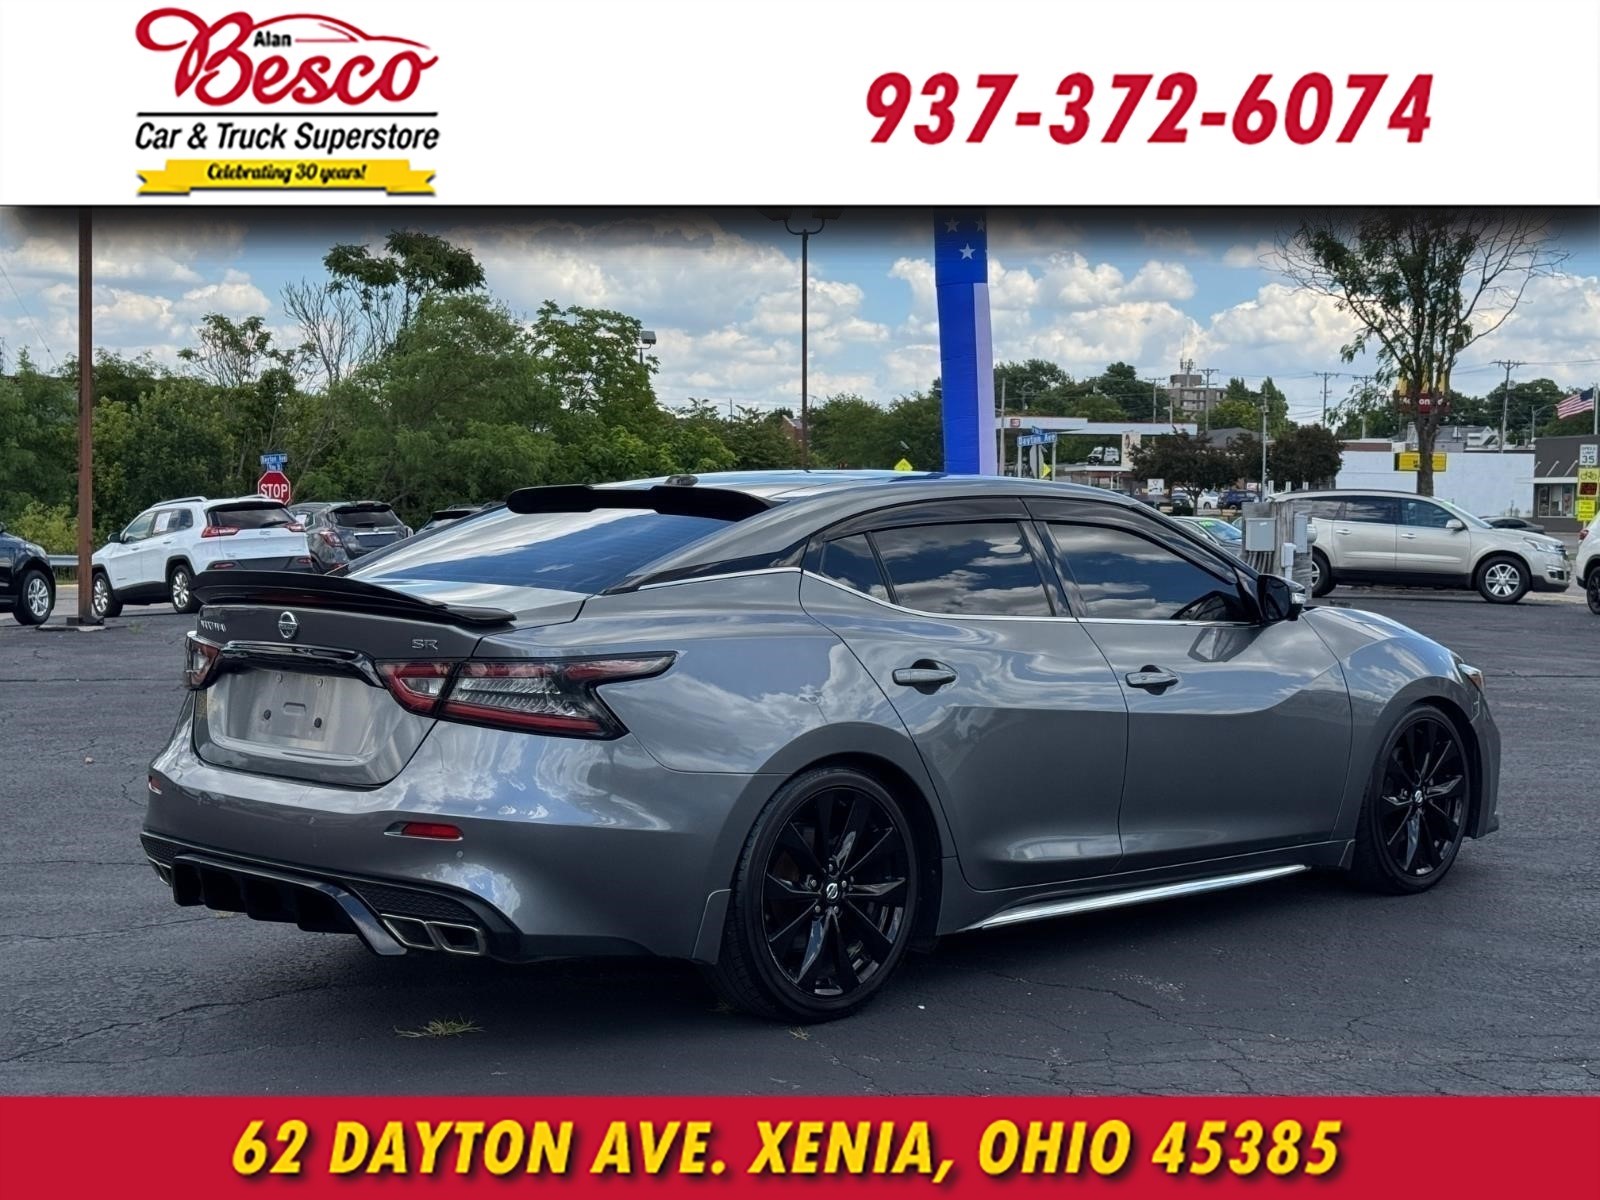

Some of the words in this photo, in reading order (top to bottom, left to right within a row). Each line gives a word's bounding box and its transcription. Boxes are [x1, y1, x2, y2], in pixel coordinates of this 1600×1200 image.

[1582, 455, 1595, 464] 35
[260, 483, 288, 499] STOP
[411, 639, 438, 650] SR
